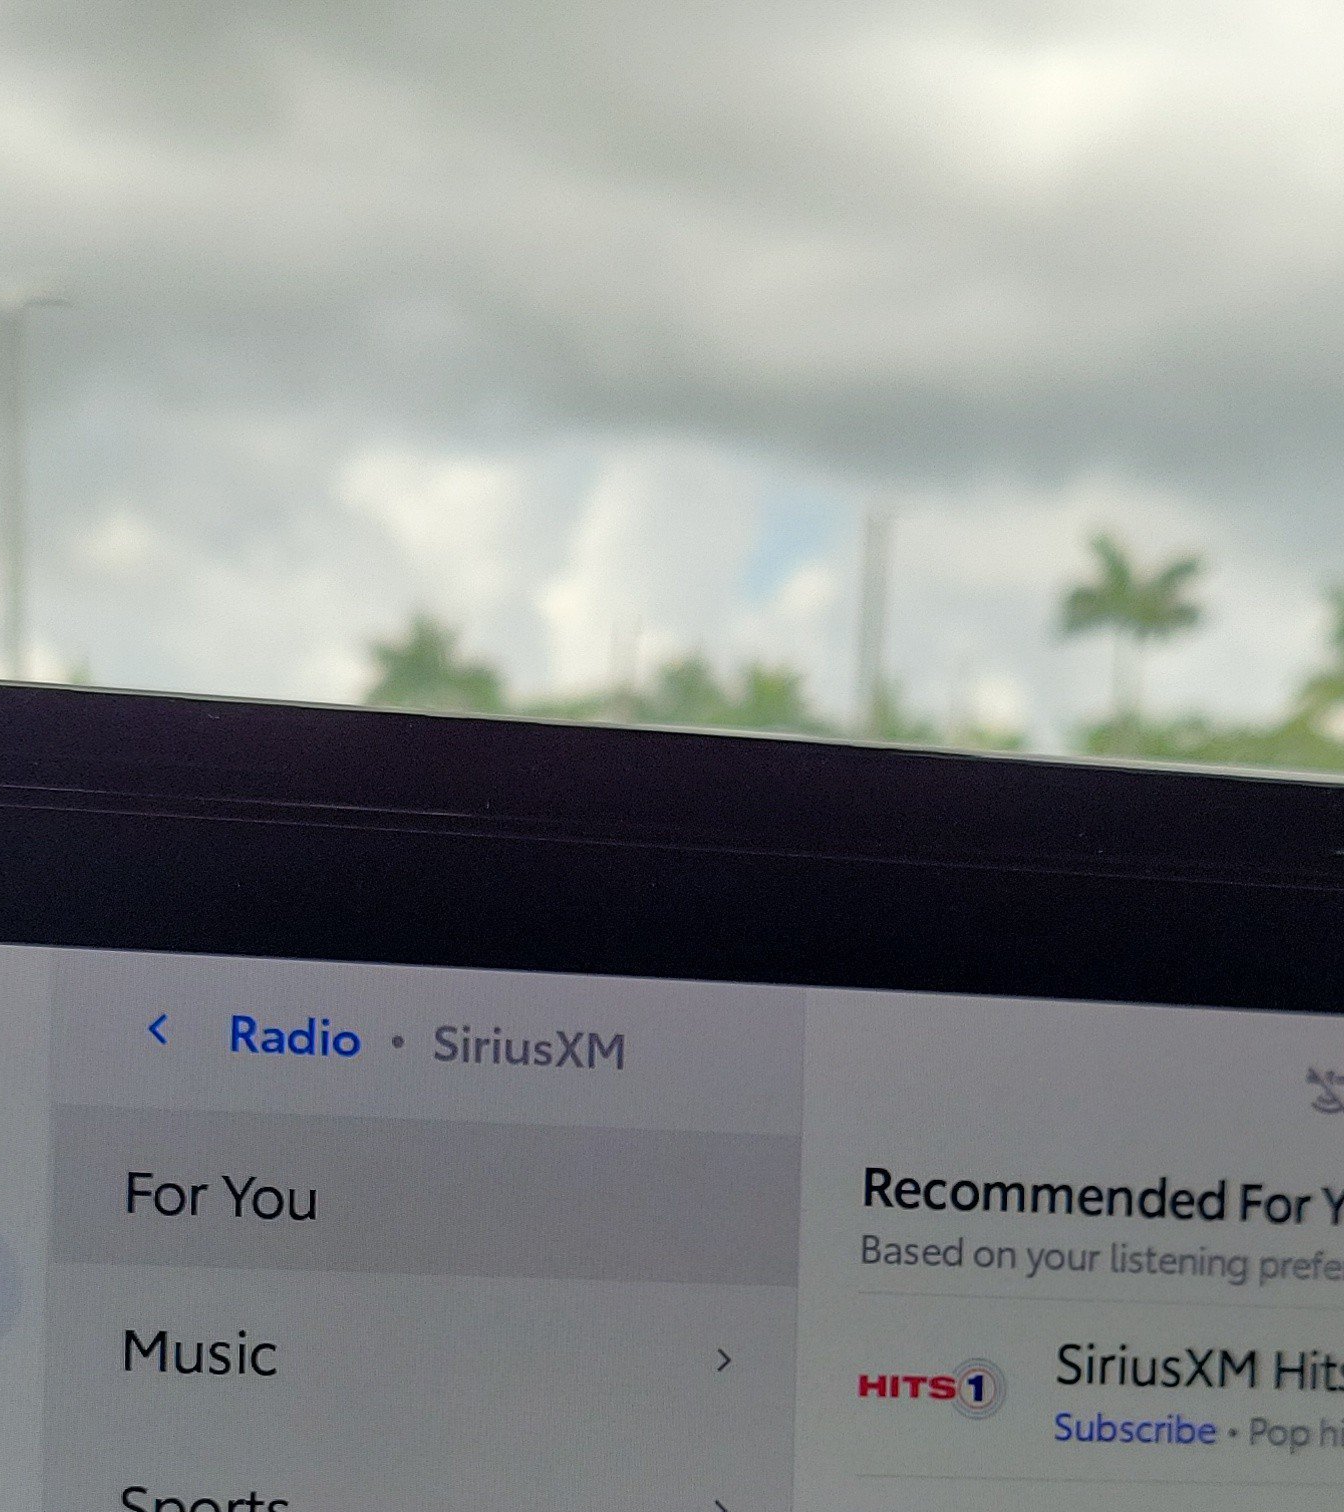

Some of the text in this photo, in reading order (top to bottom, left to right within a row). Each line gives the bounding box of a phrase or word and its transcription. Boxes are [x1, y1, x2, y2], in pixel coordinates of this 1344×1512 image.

[230, 1014, 625, 1071] Radio SiriusXM
[126, 1171, 317, 1222] For You
[864, 1166, 1228, 1223] Recommended
[1239, 1183, 1313, 1225] For
[861, 1233, 964, 1268] Based
[972, 1245, 1017, 1270] on
[1025, 1247, 1102, 1280] your
[1110, 1241, 1251, 1287] listening
[124, 1329, 277, 1377] Music
[1056, 1342, 1258, 1389] SiriusXM
[857, 1373, 958, 1401] HITS
[1054, 1411, 1219, 1446] Subscribe
[1249, 1416, 1313, 1456] Pop
